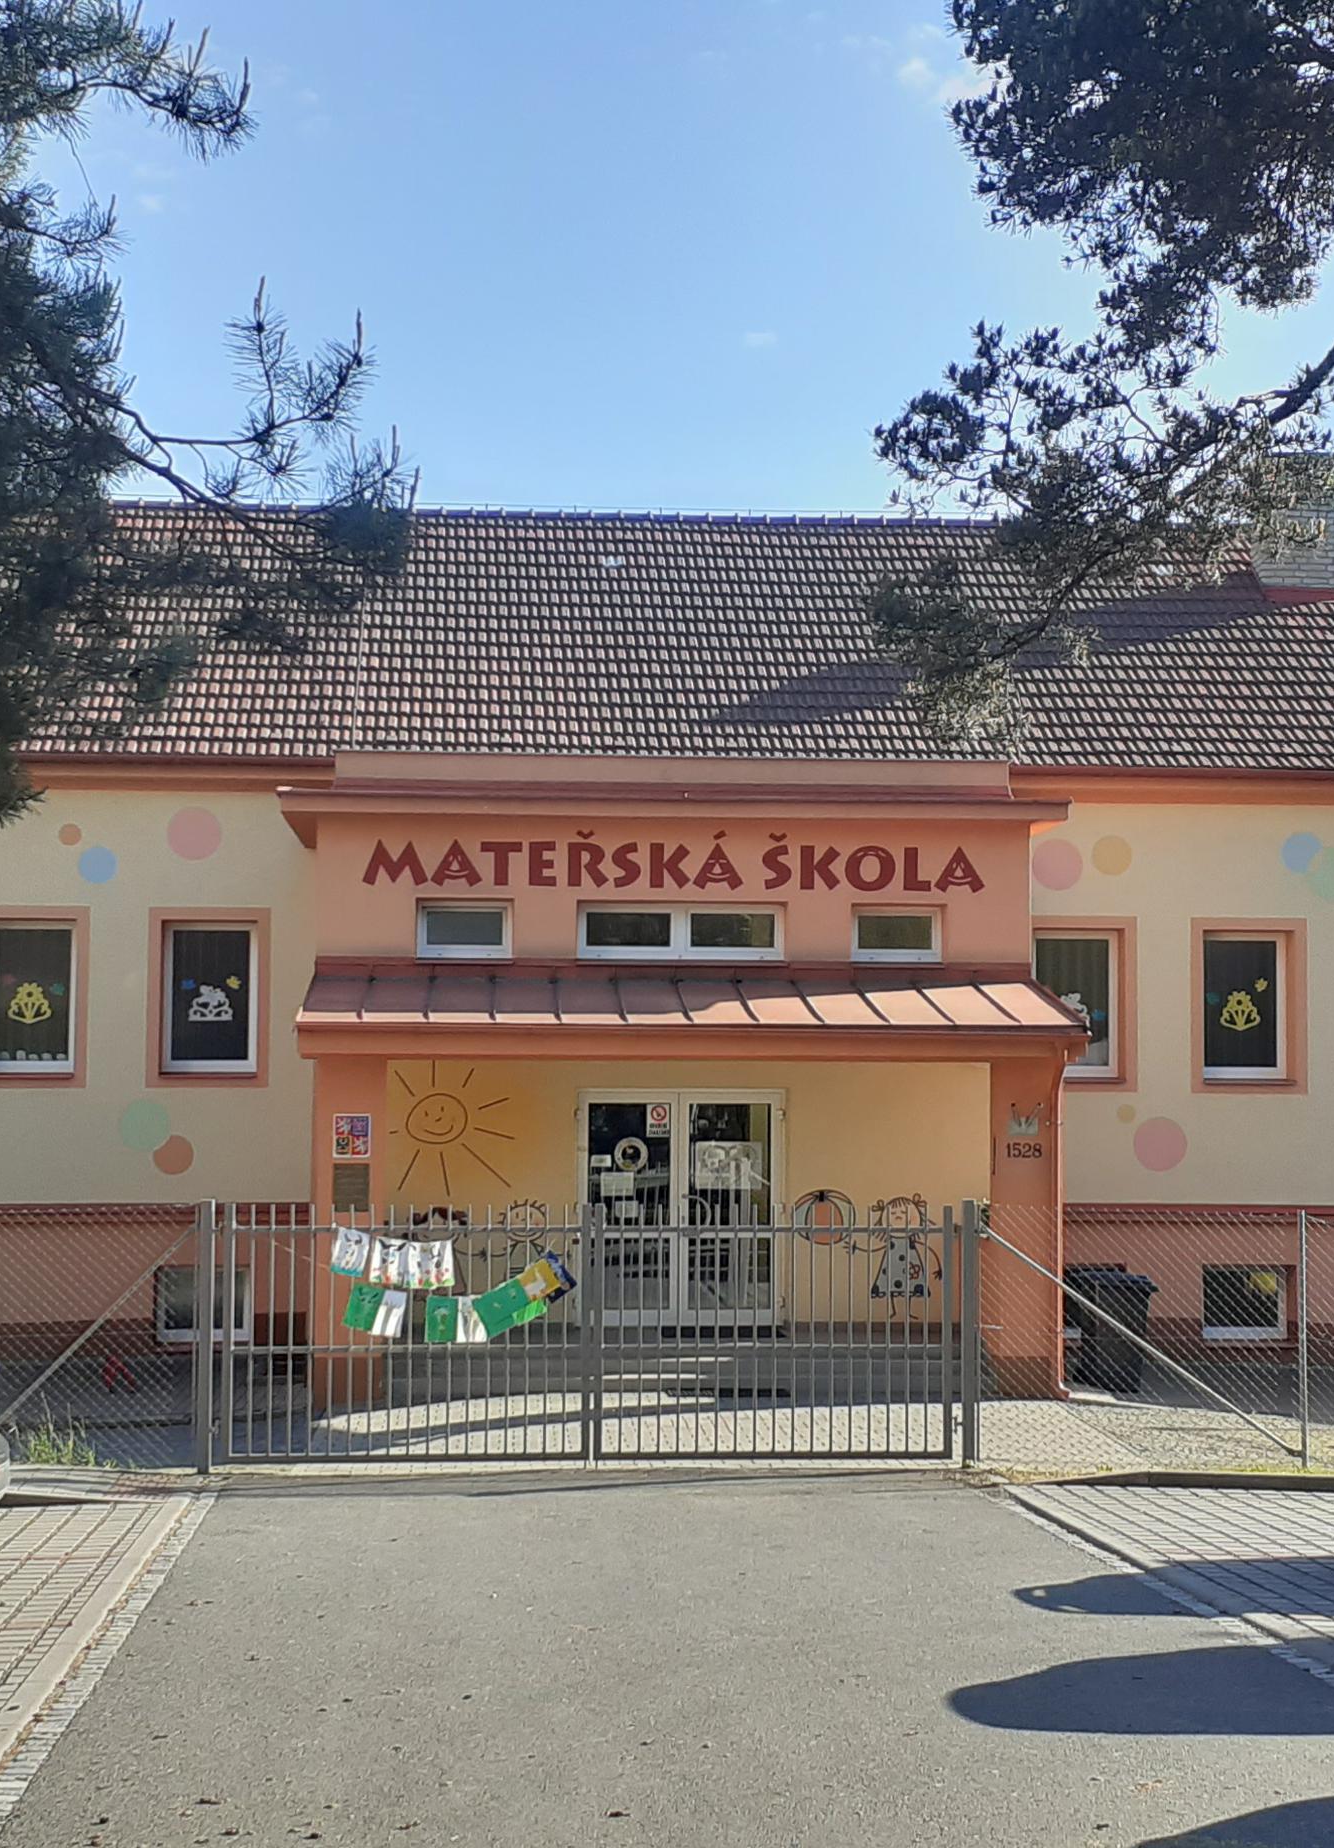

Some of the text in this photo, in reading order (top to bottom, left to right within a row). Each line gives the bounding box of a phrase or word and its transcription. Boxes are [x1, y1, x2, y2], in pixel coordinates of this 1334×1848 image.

[361, 829, 987, 894] MATEŘSKÁ ŠKOLA
[1006, 1142, 1043, 1159] 1528
